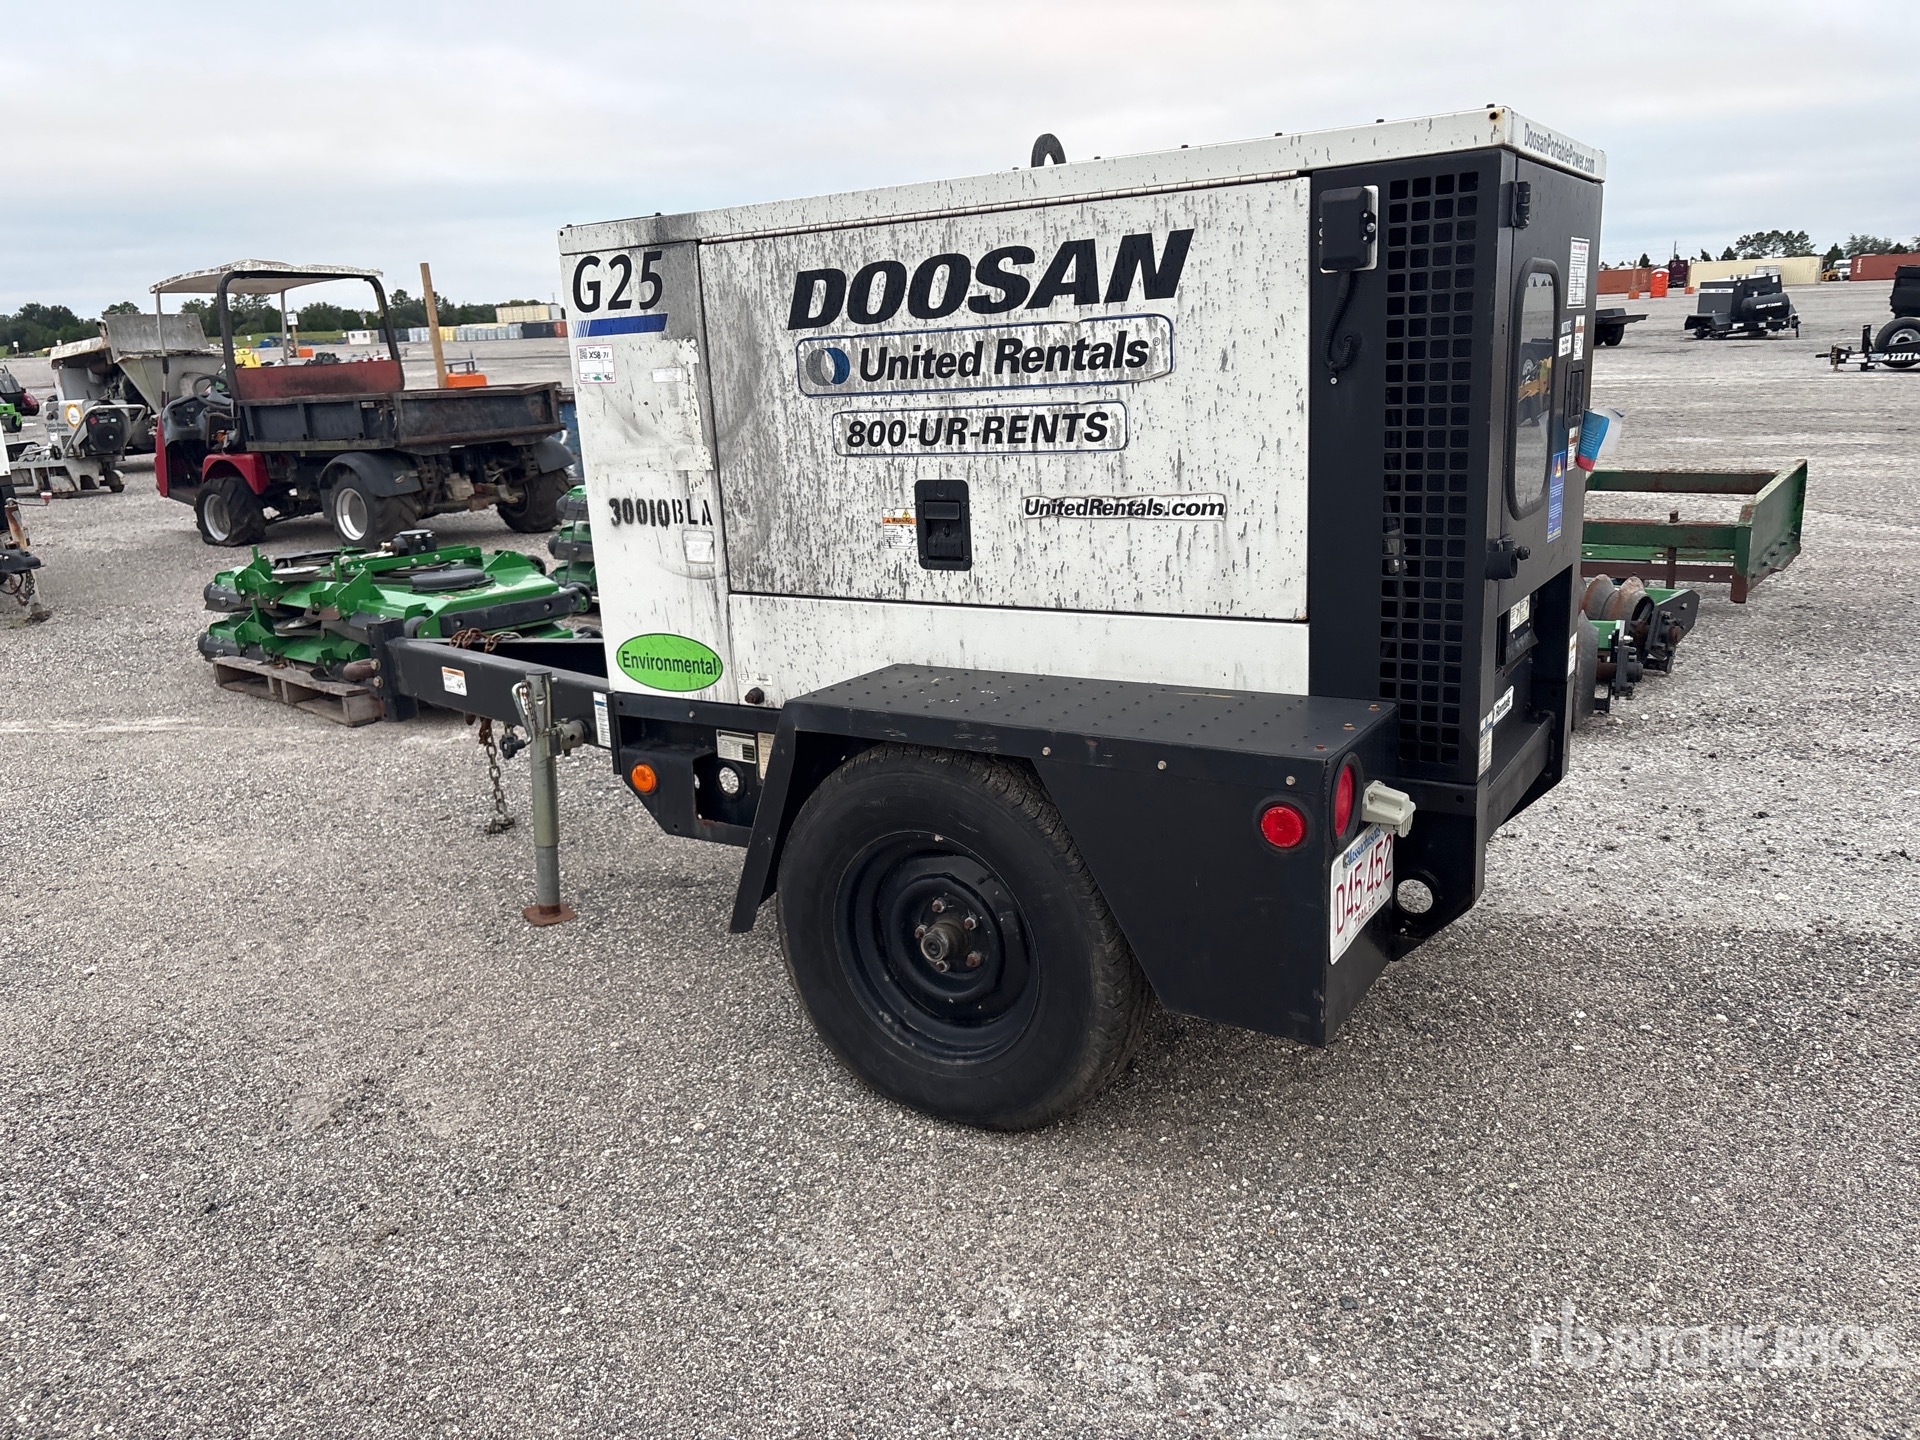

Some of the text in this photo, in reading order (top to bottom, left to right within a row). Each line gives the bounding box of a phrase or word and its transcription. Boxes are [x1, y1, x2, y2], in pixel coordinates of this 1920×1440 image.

[572, 250, 663, 313] G25
[788, 228, 1195, 330] DOOSAN
[860, 331, 1149, 382] United Rentals
[846, 411, 1110, 448] 800-UR-RENTS
[1024, 497, 1226, 519] UnitedRentals.com
[622, 651, 717, 675] Environmental
[1352, 895, 1376, 928] TRAILER
